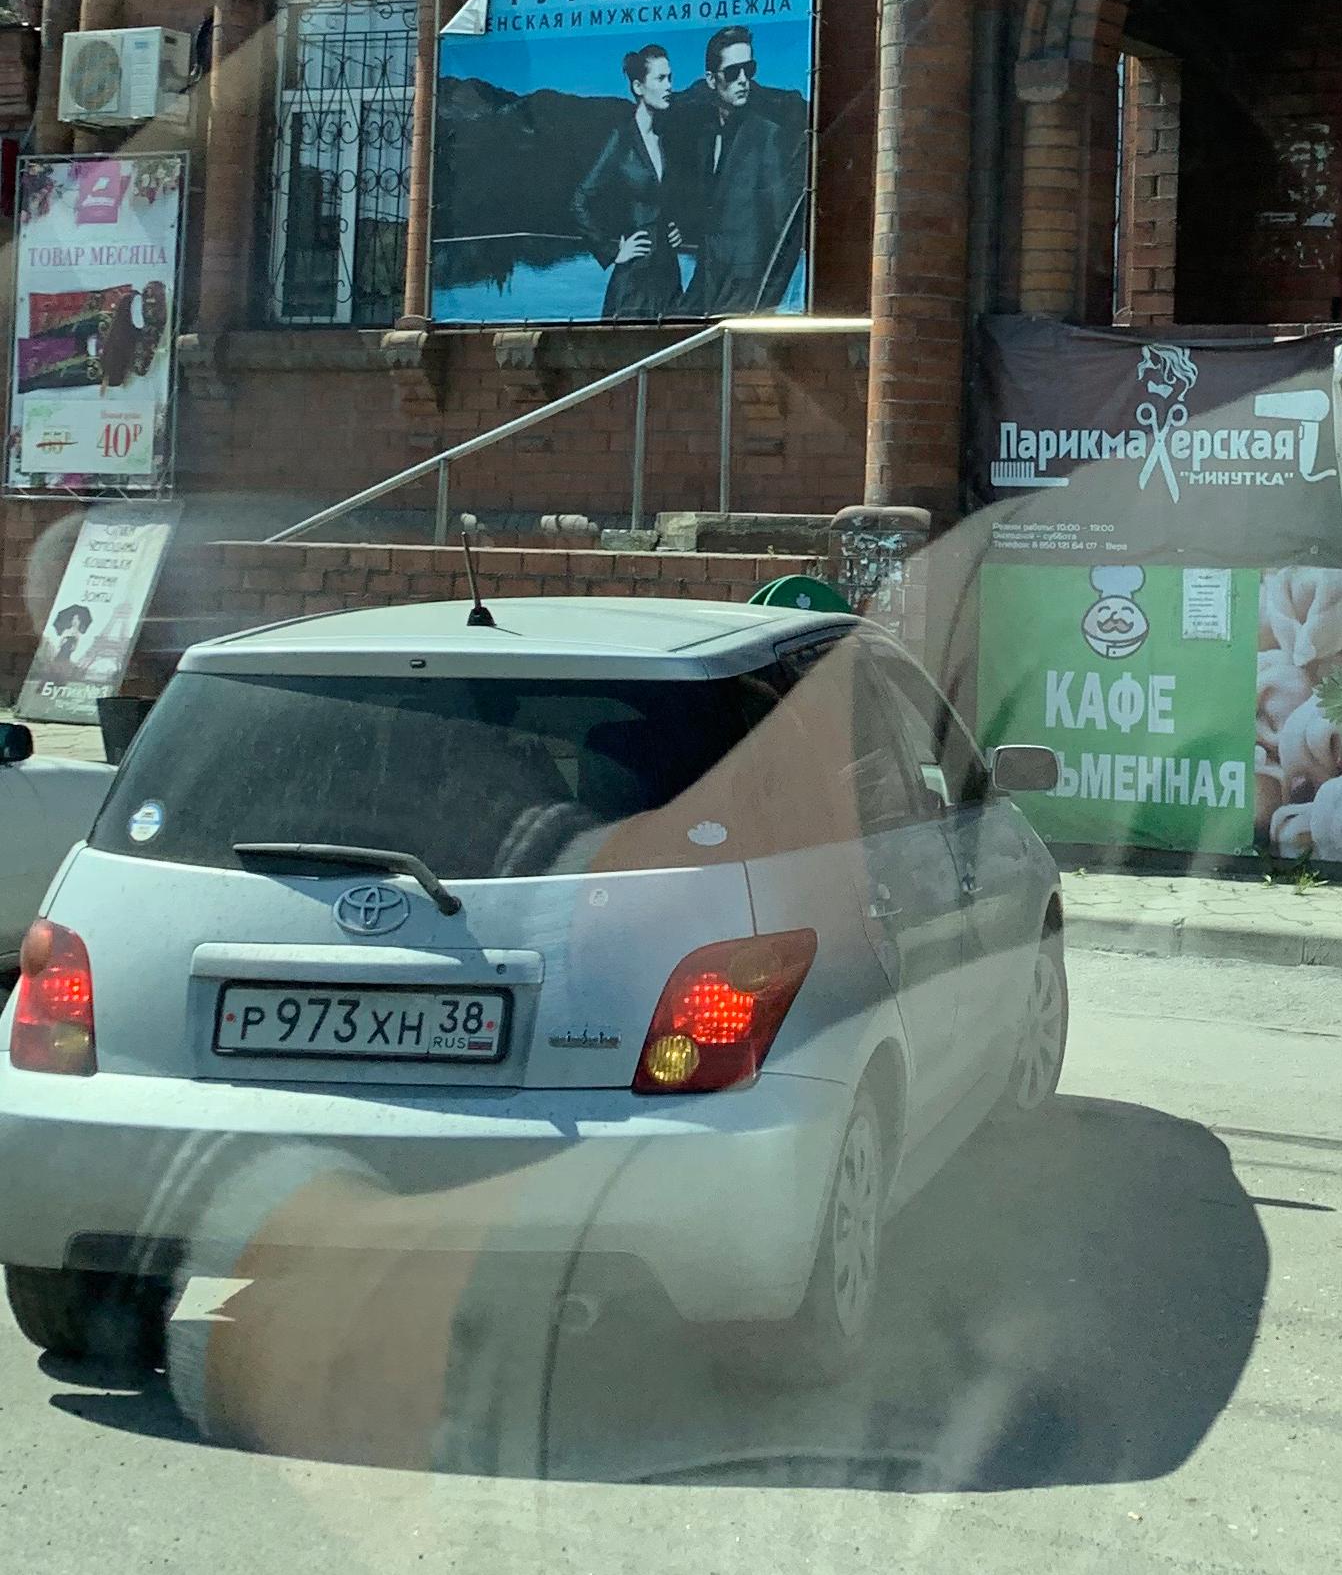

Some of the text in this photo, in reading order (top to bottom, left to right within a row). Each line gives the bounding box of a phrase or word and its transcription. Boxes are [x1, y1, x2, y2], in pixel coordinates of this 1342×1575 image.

[486, 12, 563, 33] ЕНСКАЯ
[566, 11, 582, 27] И
[590, 1, 692, 25] МУЖСКАЯ
[28, 244, 168, 267] ТОВАР МЕСЯЦА
[1045, 670, 1176, 734] КАФЕ
[439, 1001, 484, 1034] 38
[433, 1036, 467, 1050] RUS
